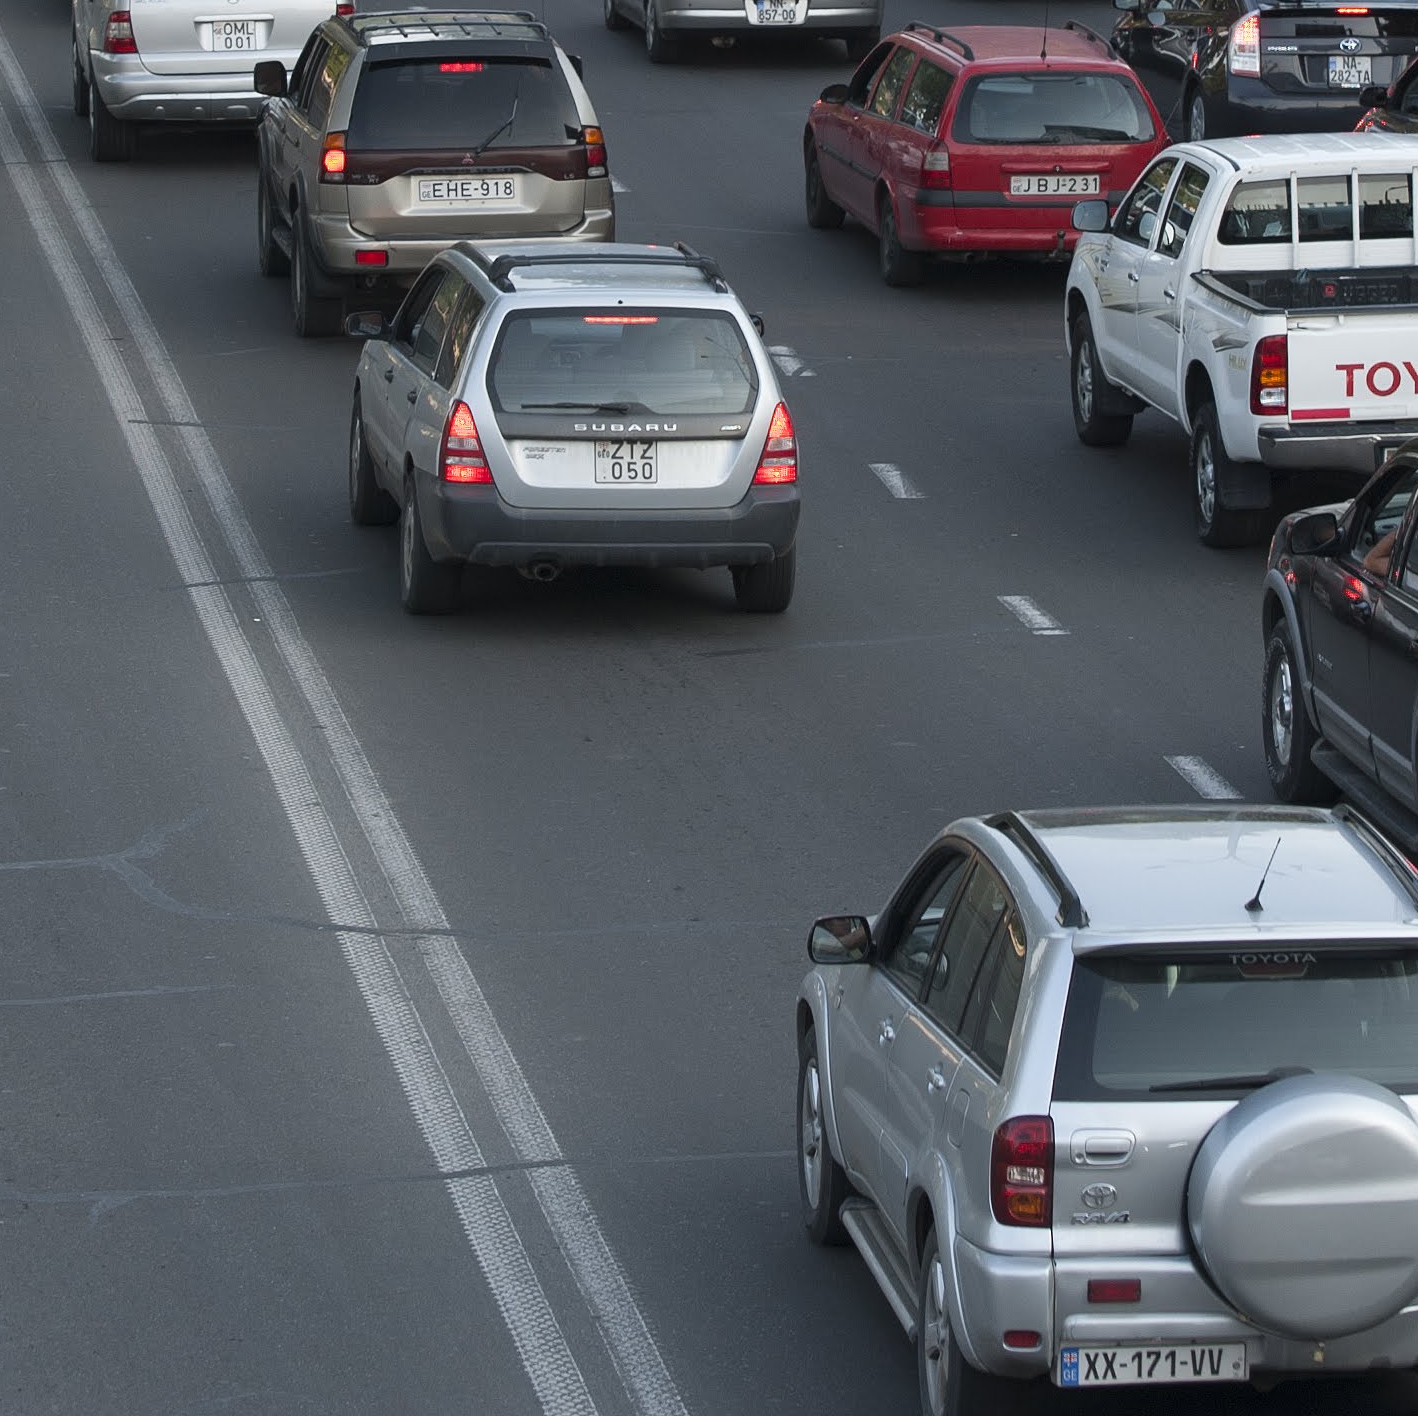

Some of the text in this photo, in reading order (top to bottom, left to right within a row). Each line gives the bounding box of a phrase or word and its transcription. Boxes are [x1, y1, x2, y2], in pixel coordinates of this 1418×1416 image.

[222, 22, 254, 37] OML
[224, 37, 252, 50] 001
[432, 180, 514, 199] EHE-918
[573, 422, 678, 433] SUBARU
[611, 460, 654, 481] 050
[1228, 952, 1318, 964] TOYOTA
[1084, 1348, 1224, 1382] XX-171-VV
